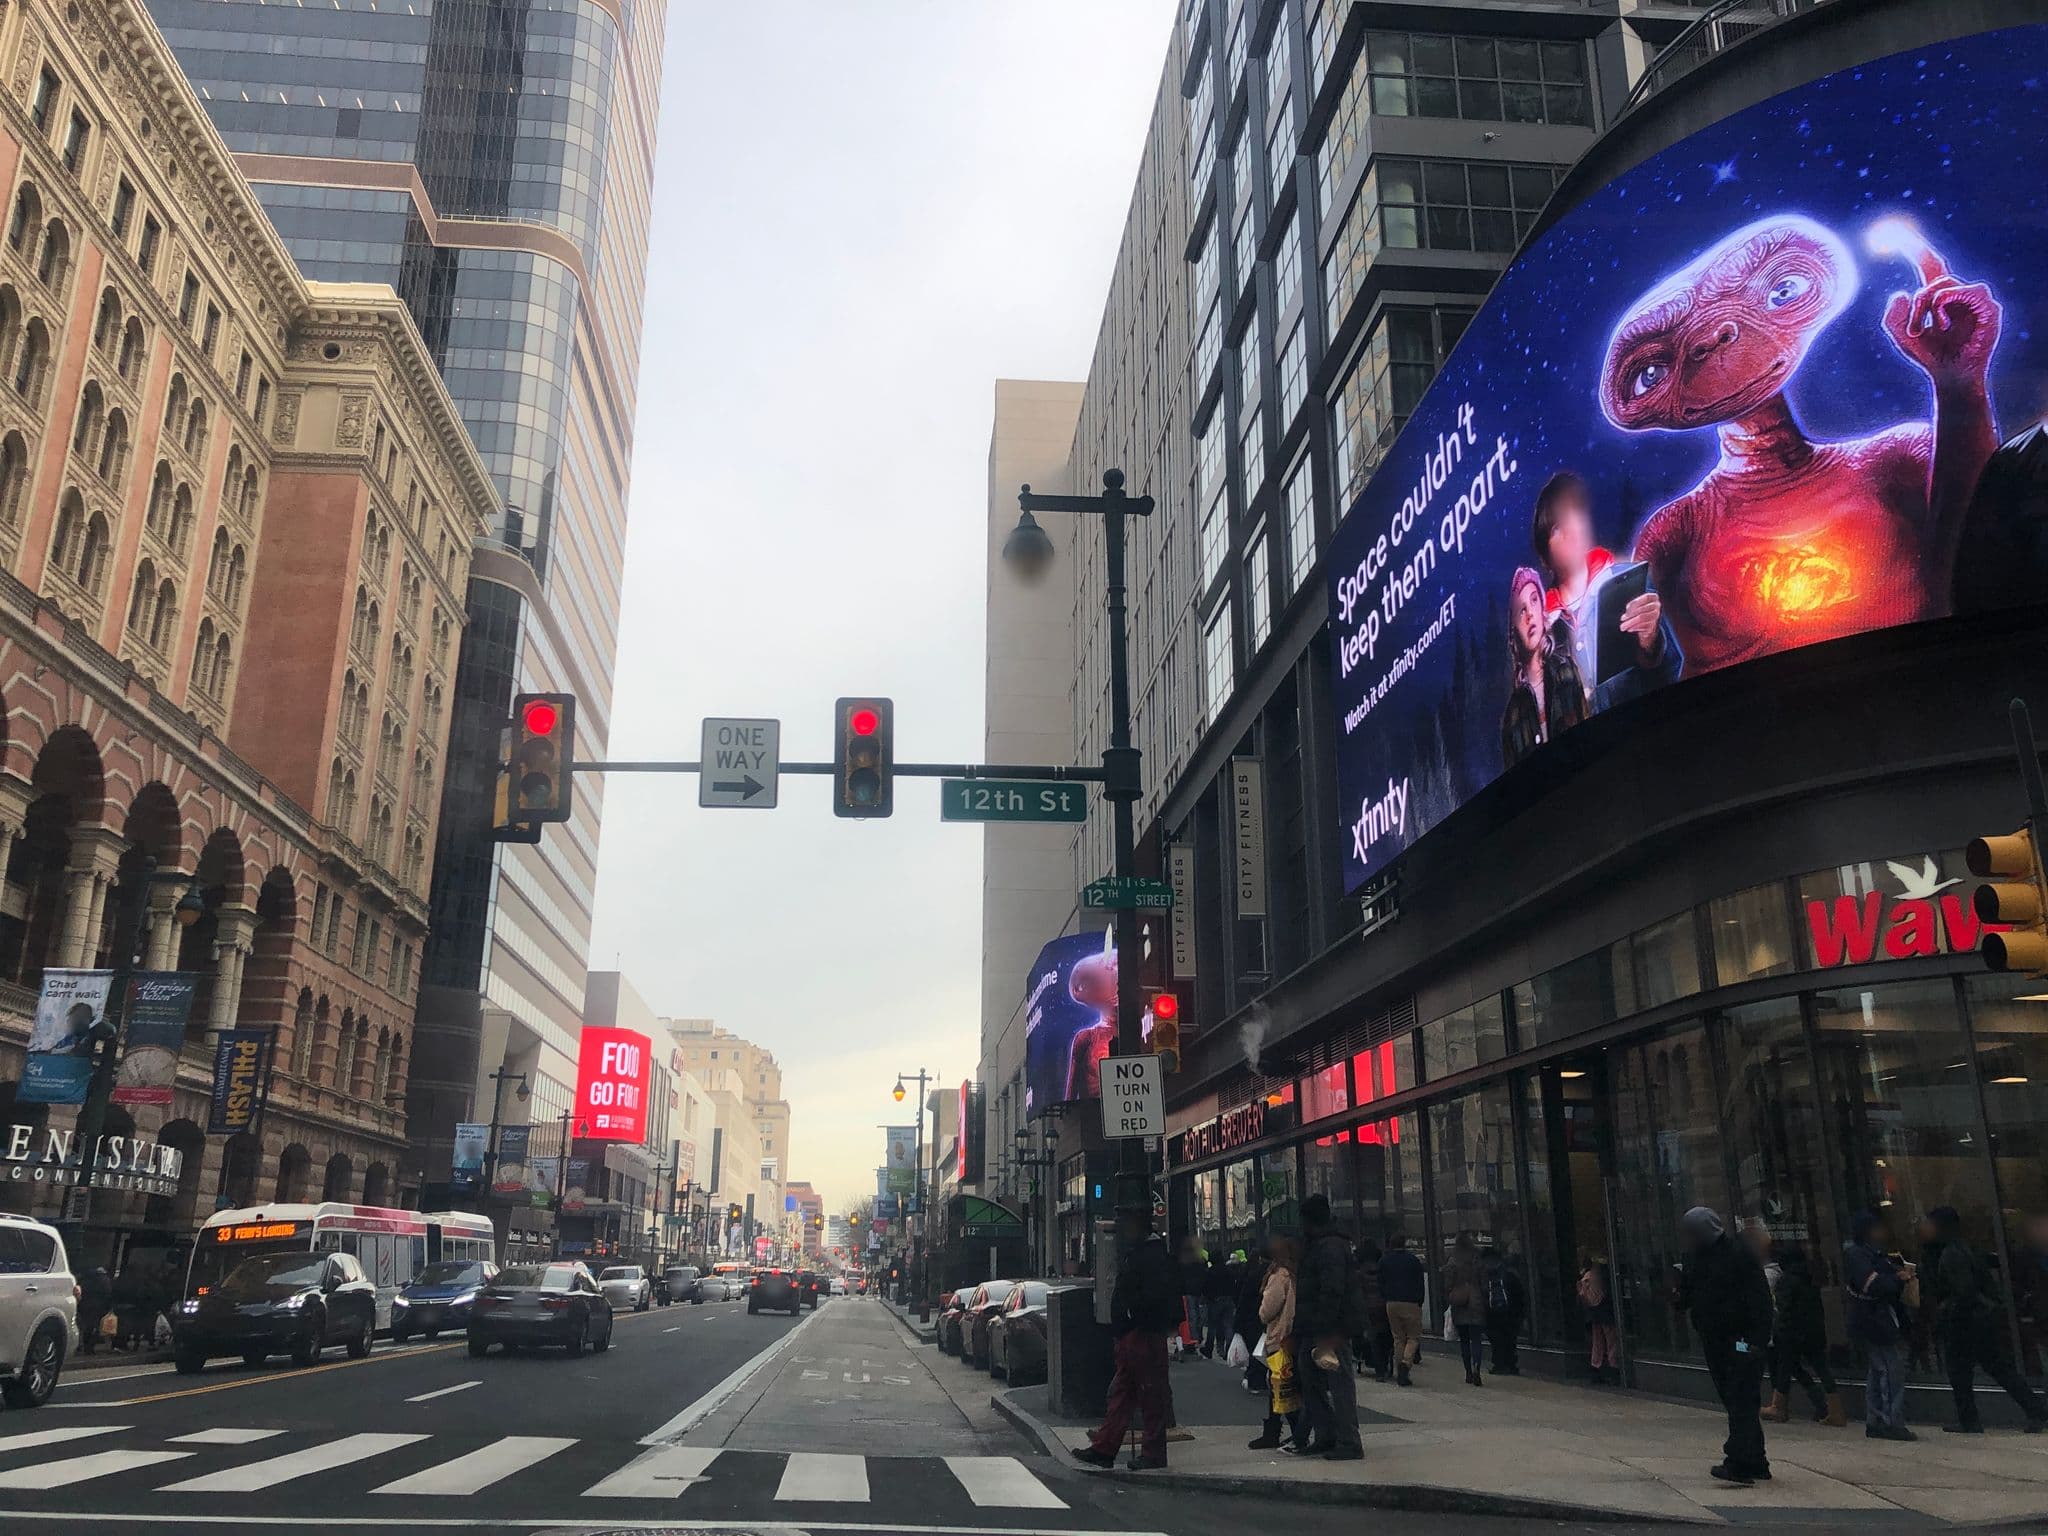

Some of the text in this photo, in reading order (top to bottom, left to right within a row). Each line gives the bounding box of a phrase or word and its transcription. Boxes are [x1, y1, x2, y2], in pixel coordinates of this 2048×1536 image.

[1337, 400, 1477, 624] Space couldn't
[1340, 436, 1517, 679] keep them apart.
[1344, 593, 1456, 735] Watch it at xfinity.com/ET
[718, 726, 765, 747] ONE
[715, 750, 766, 769] WAY
[960, 788, 1072, 812] 12th St
[1352, 776, 1408, 864] xfinity
[1238, 775, 1252, 899] CITY FITNESS
[1136, 894, 1172, 906] STREET
[1175, 858, 1186, 964] CITY FITNESS
[48, 980, 78, 989] Chad
[601, 1042, 640, 1078] FOOD
[1116, 1063, 1144, 1078] NO
[224, 1040, 258, 1126] PHLASH
[590, 1082, 614, 1106] GO
[616, 1083, 633, 1108] FOR
[1114, 1083, 1150, 1096] TURN
[1123, 1102, 1144, 1113] ON
[1121, 1118, 1148, 1130] RED
[1201, 1119, 1220, 1157] HILL
[1221, 1102, 1265, 1150] BREWERY
[218, 1228, 231, 1242] 33
[263, 1224, 295, 1237] LANDING
